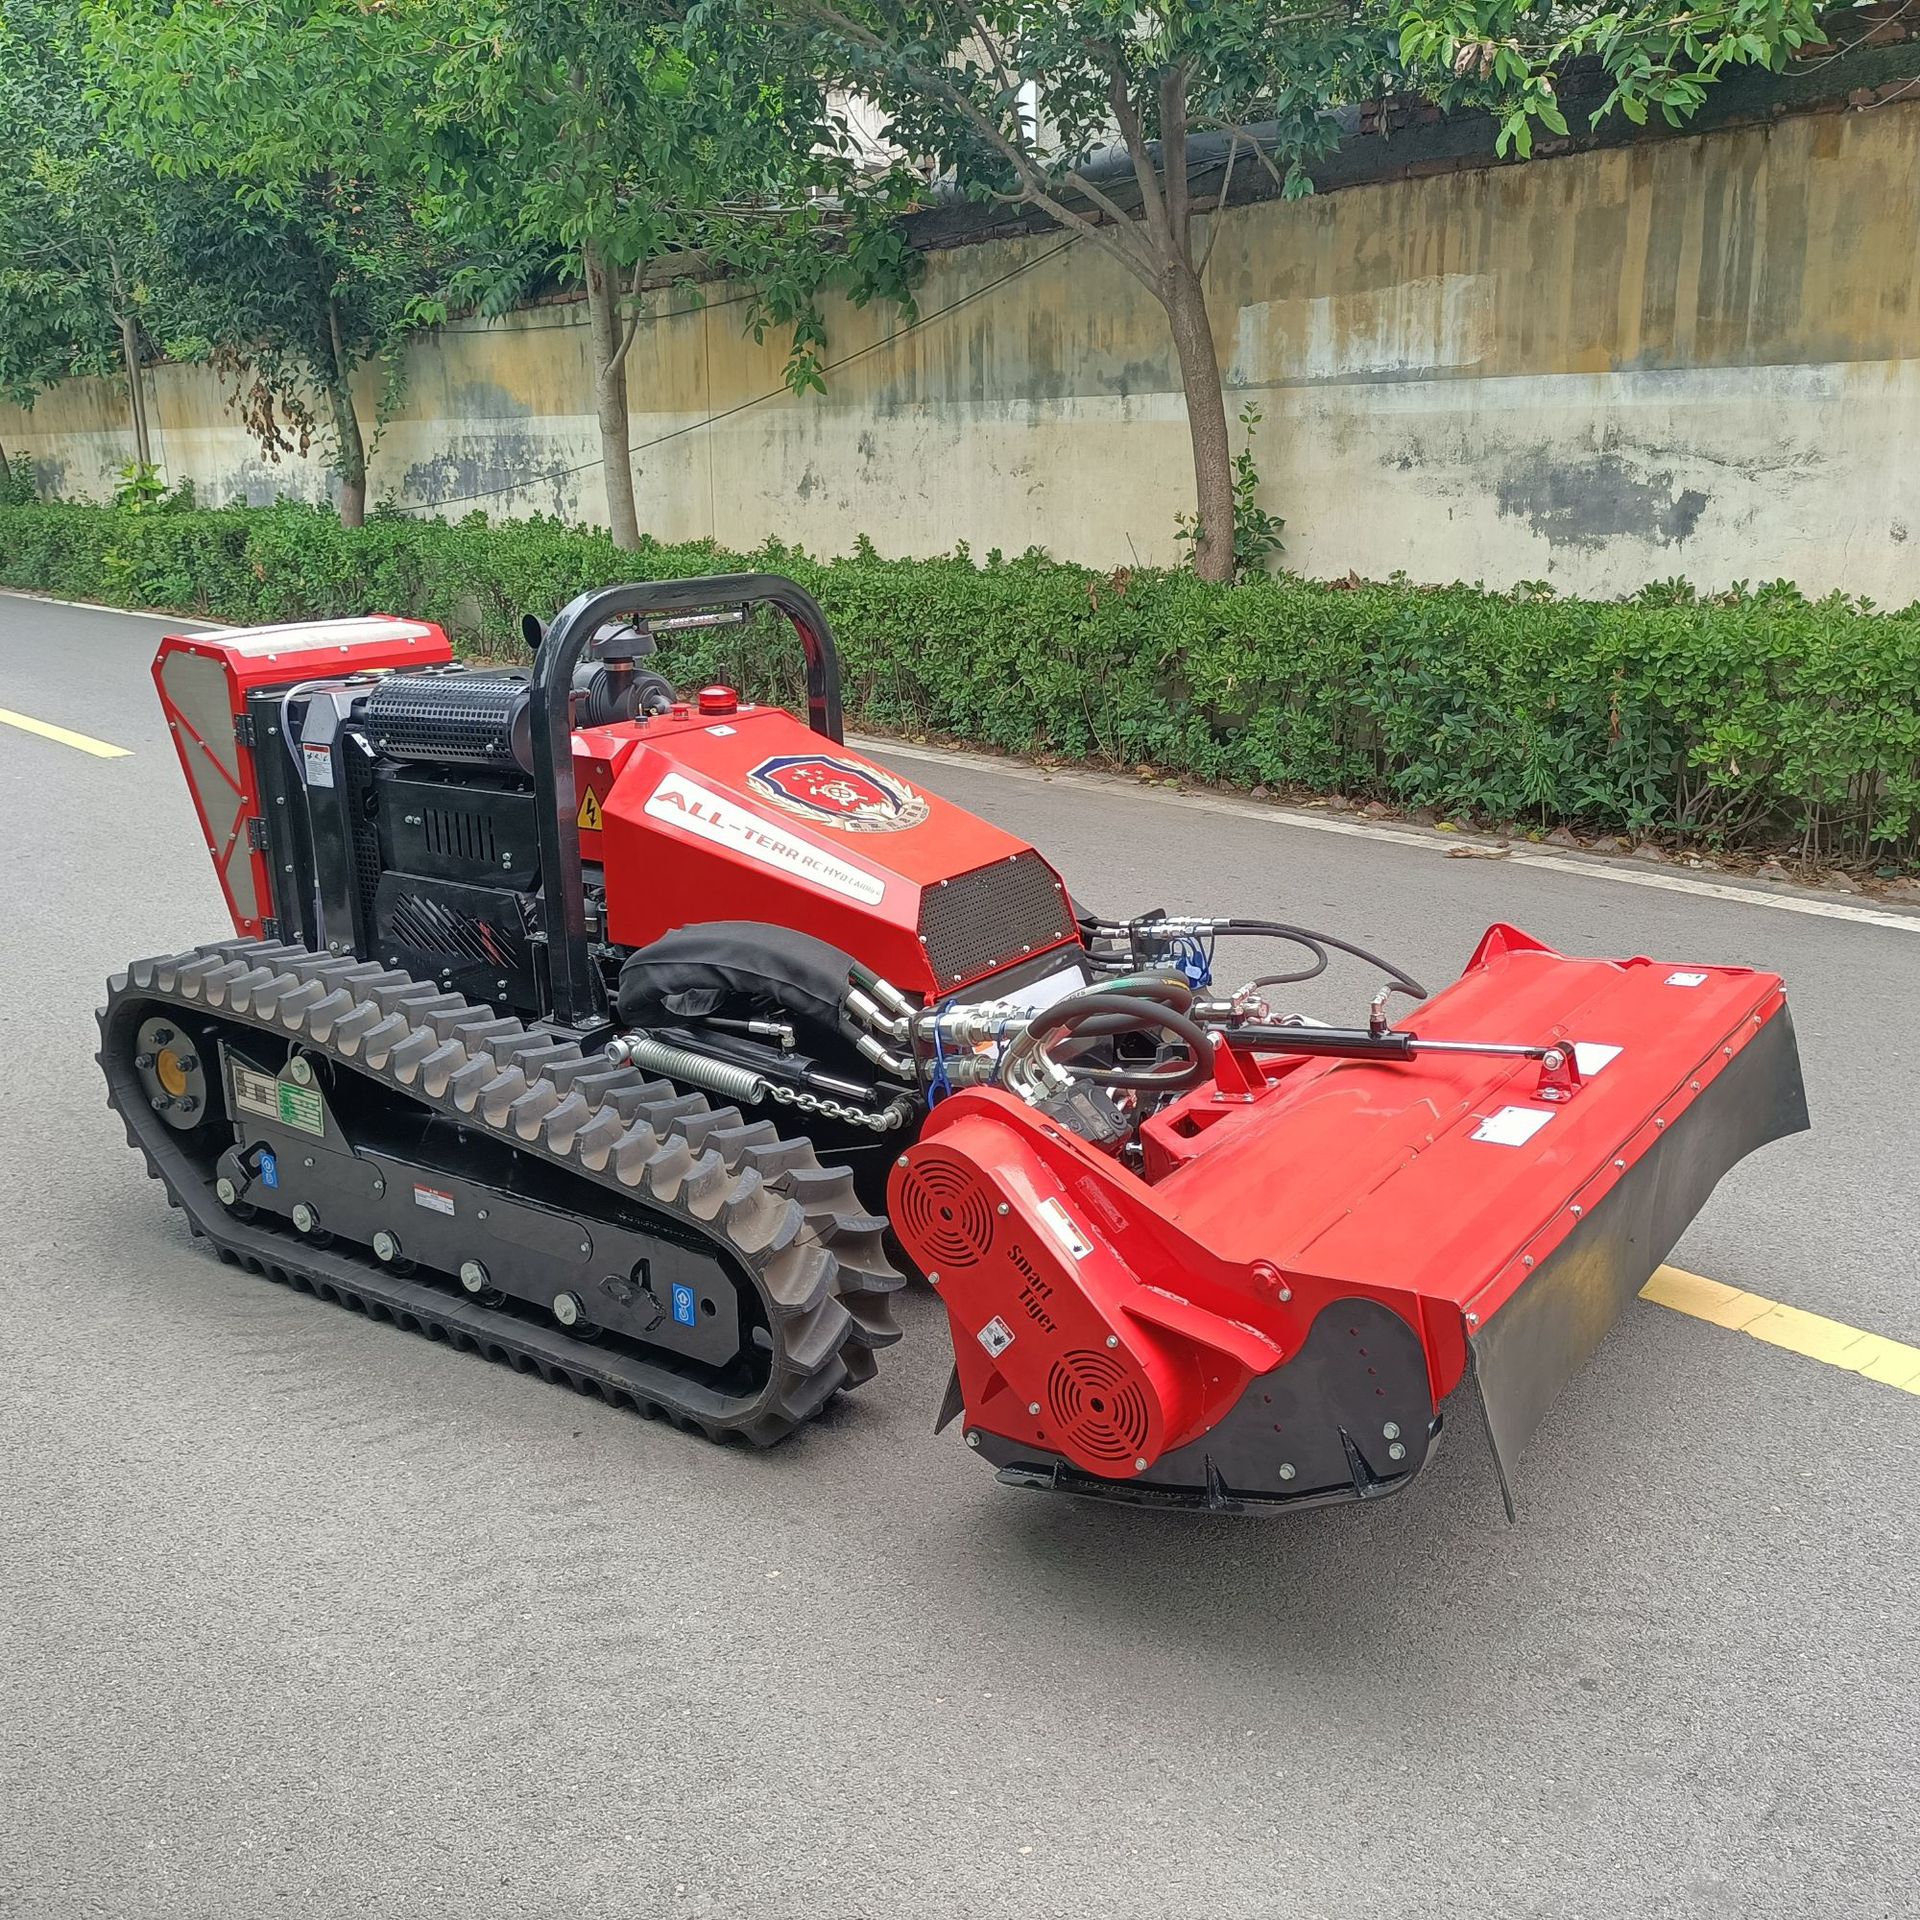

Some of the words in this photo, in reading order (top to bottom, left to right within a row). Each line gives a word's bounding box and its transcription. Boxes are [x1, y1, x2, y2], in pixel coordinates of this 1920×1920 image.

[654, 791, 800, 861] ALL-TERR
[801, 855, 824, 871] RC
[1007, 1245, 1053, 1300] Smart
[1019, 1285, 1057, 1334] Tiger
